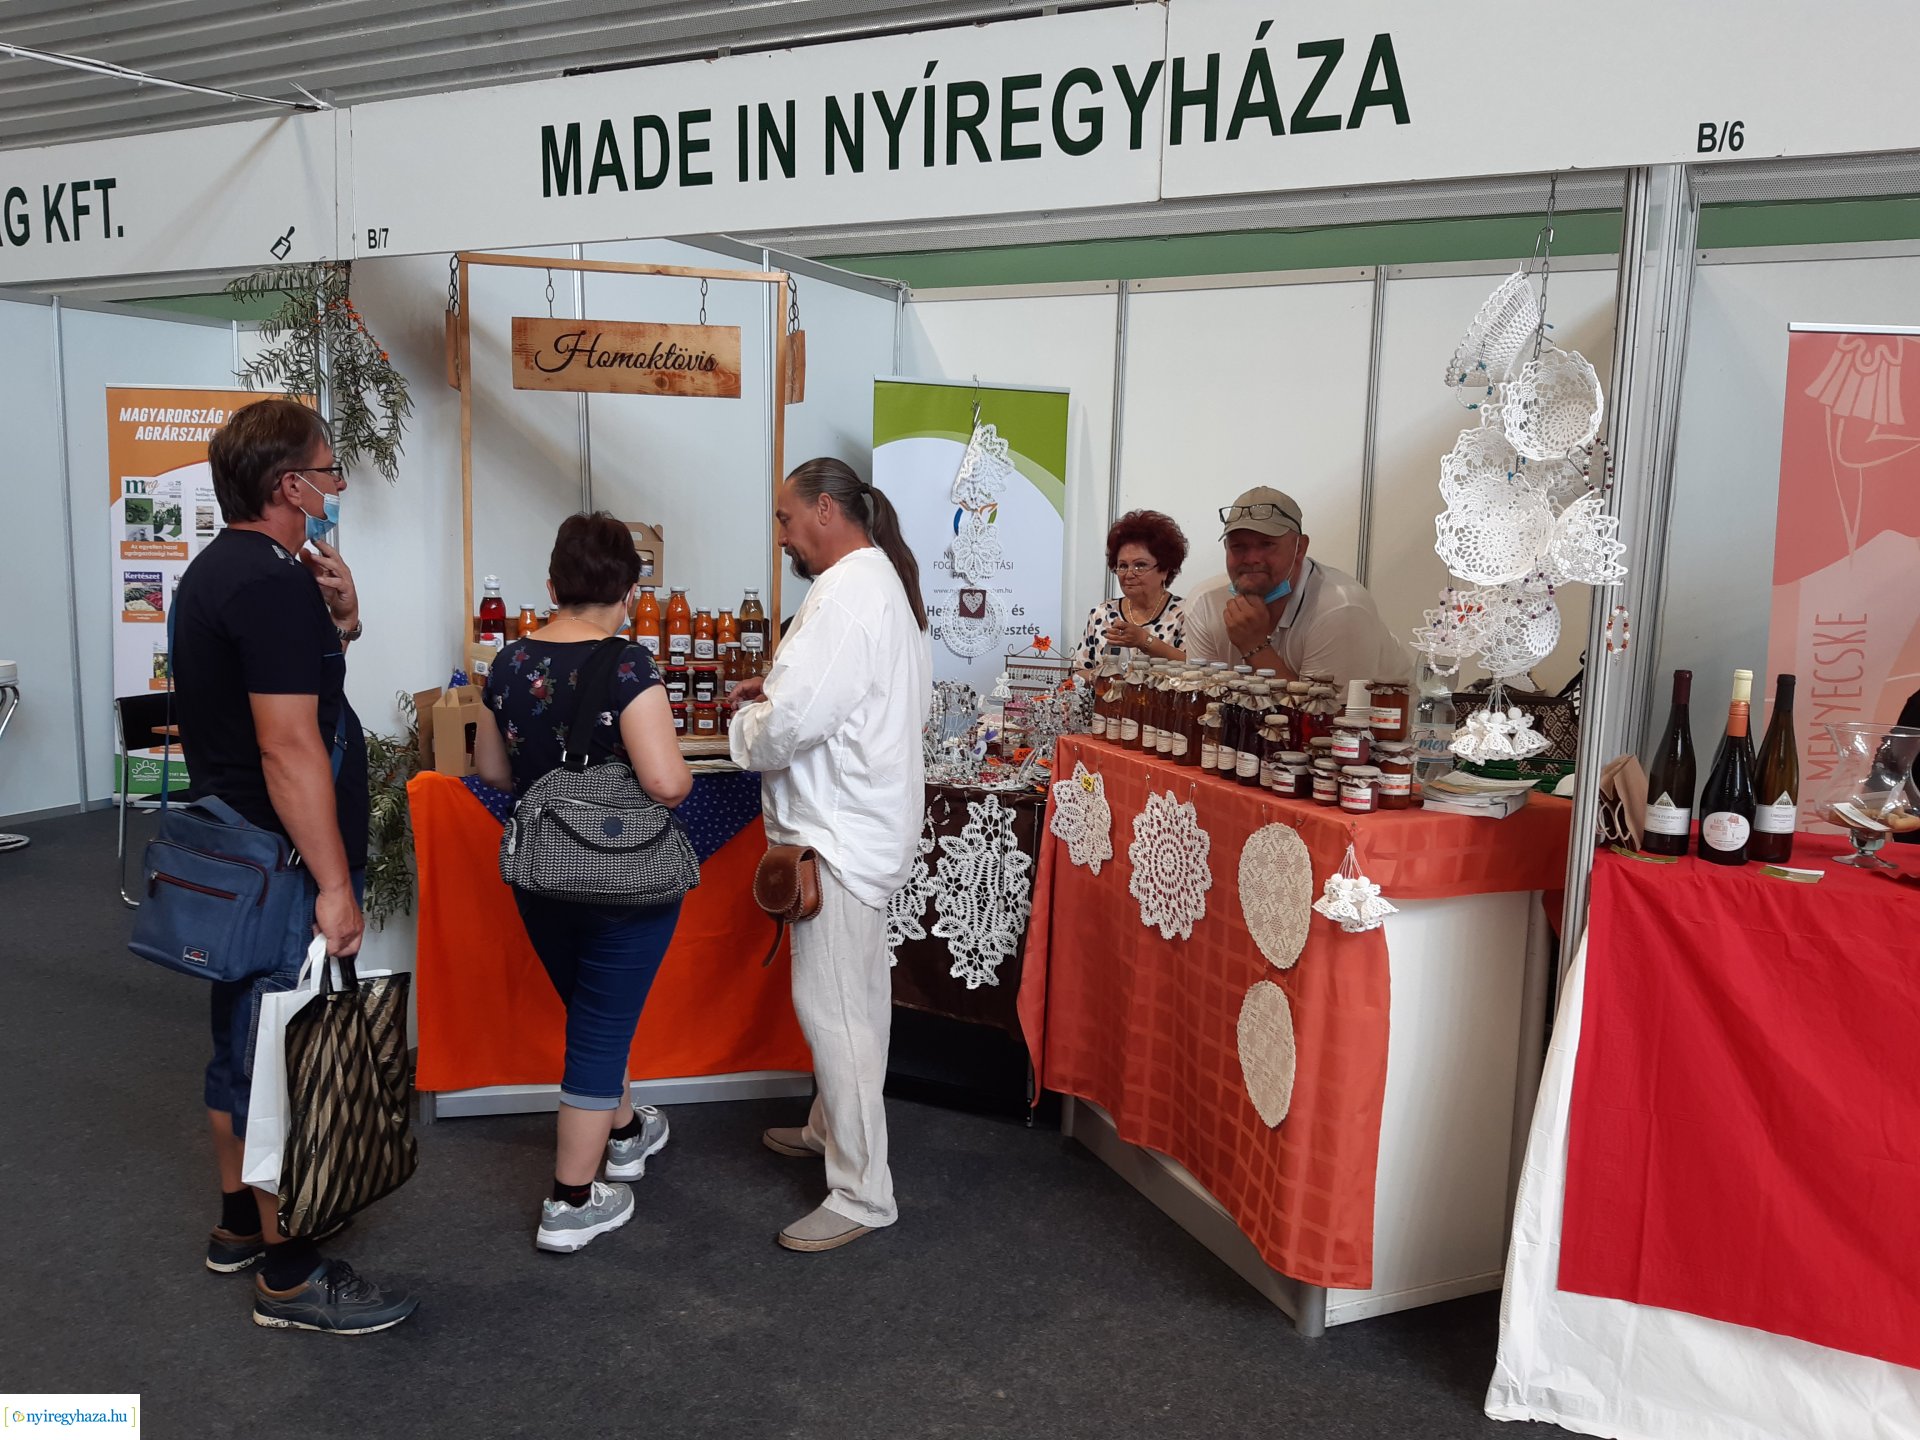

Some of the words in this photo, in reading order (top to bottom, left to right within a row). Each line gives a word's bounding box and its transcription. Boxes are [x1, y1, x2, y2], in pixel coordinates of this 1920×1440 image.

[541, 108, 713, 198] MADE
[738, 100, 796, 183] IN
[825, 19, 1411, 175] NYÍREGYHÁZA
[1697, 120, 1745, 153] B/6
[0, 186, 30, 247] G
[43, 177, 124, 244] KFT.
[368, 227, 389, 249] B/7
[534, 330, 718, 373] Homoktövis
[119, 407, 225, 424] MAGYARORSZÁG
[125, 572, 160, 580] Kertészet
